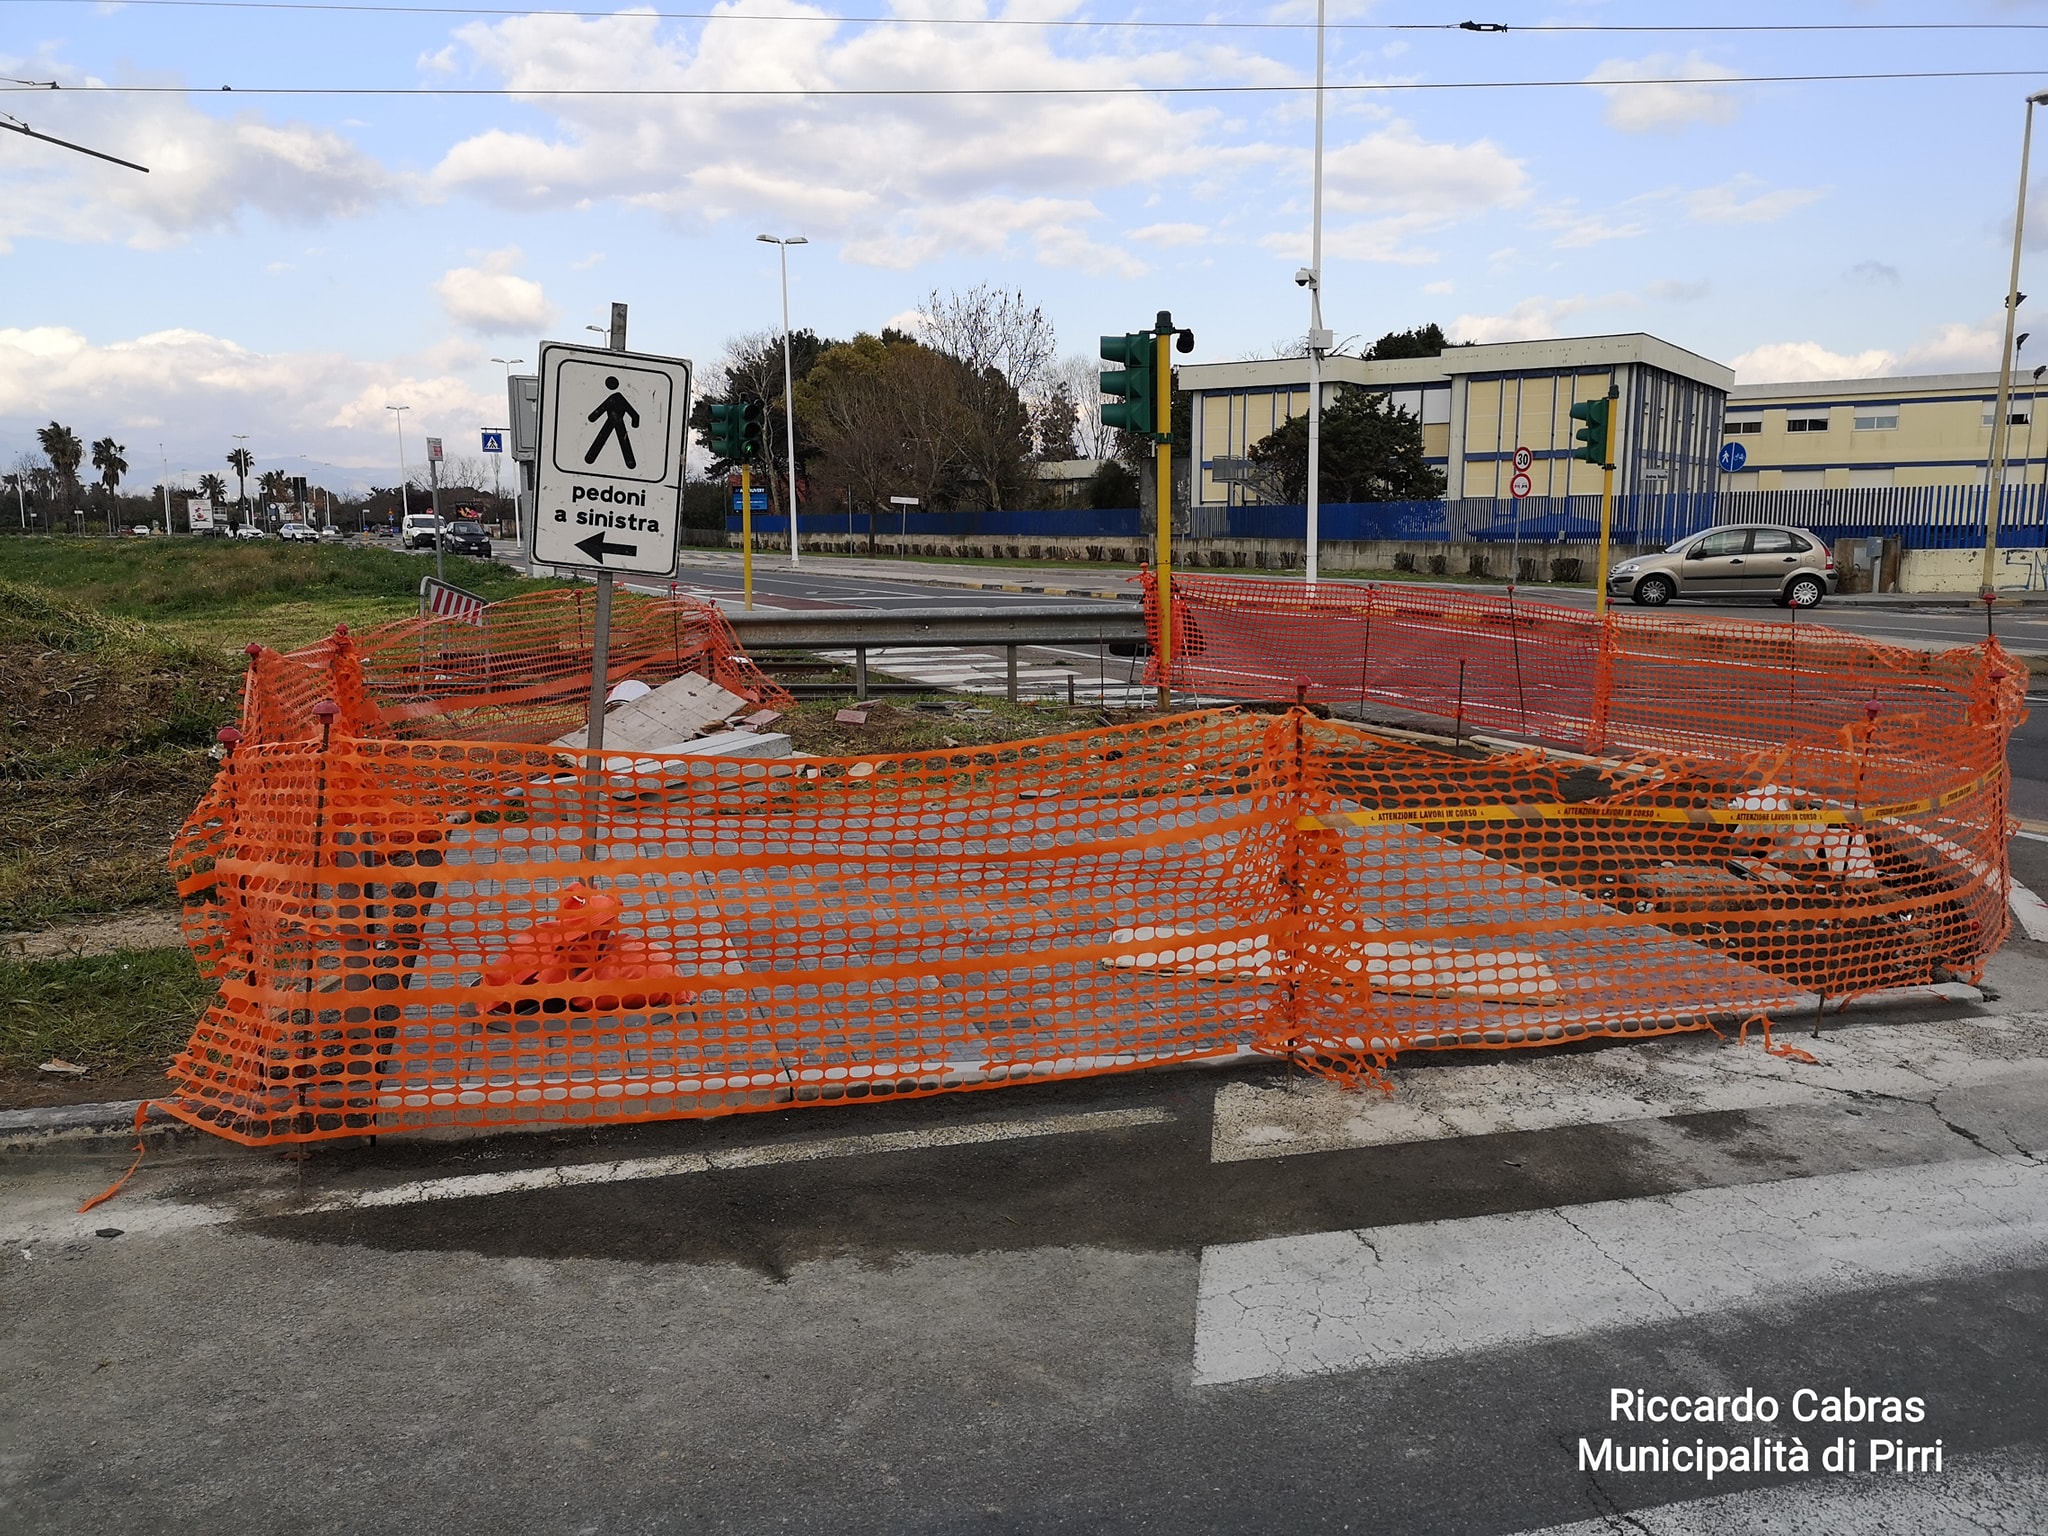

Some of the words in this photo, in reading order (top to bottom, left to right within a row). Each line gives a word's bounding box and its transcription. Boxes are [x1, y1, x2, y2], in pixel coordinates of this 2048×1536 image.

[1517, 453, 1528, 466] 30
[572, 485, 646, 507] pedoni
[554, 509, 567, 523] a
[576, 508, 659, 532] sinistra
[1378, 811, 1417, 821] ATTENZIONE
[1419, 810, 1444, 820] LAVORI
[1446, 809, 1453, 818] IN
[1455, 808, 1477, 817] CORSO
[1563, 807, 1599, 816] ATTENZIONE
[1602, 808, 1623, 817] LAVORI
[1624, 809, 1632, 817] IN
[1633, 809, 1654, 818] CORSO
[1736, 813, 1770, 821] ATTENZIONE
[1770, 813, 1791, 821] LAVORI
[1792, 813, 1798, 821] IN
[1799, 813, 1816, 821] CORSO
